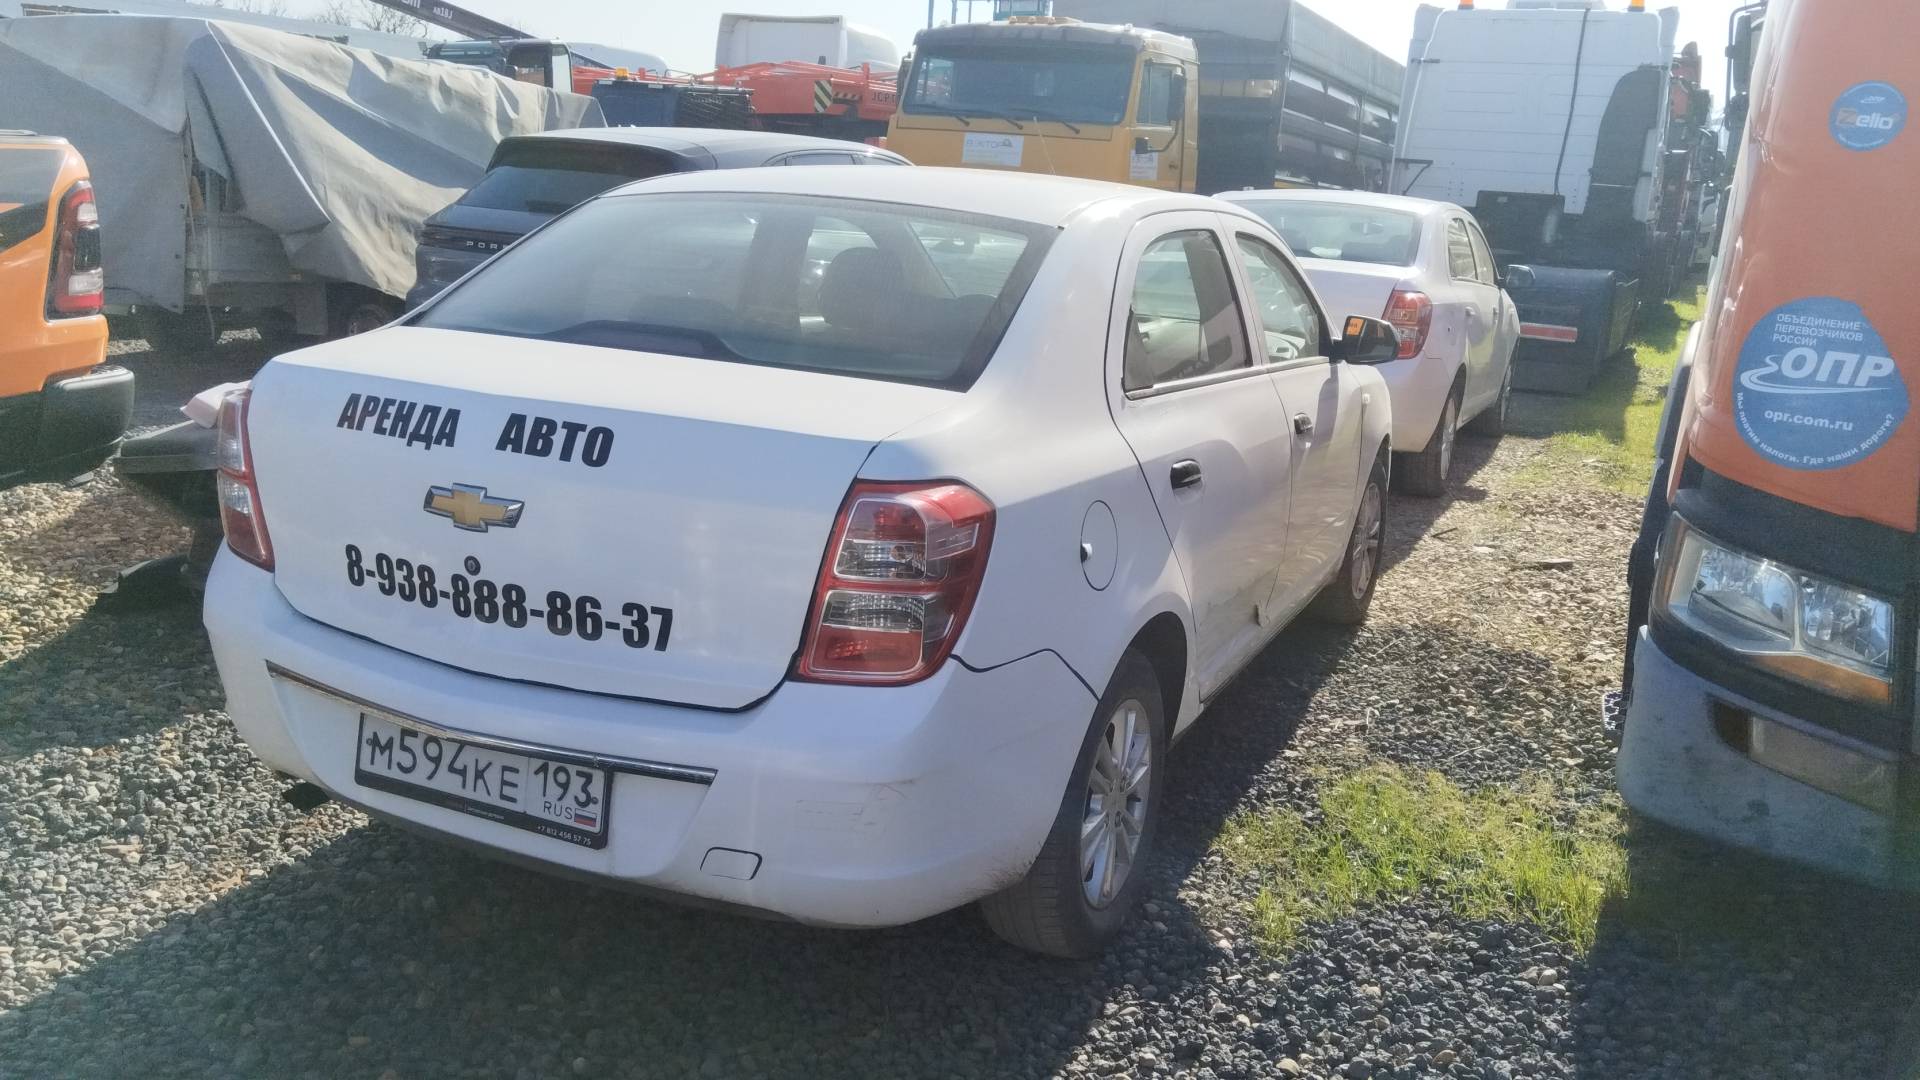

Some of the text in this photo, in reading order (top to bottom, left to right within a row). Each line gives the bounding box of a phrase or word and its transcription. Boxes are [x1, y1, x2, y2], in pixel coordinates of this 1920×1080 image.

[1774, 323, 1864, 341] ПЕРЕВОЗЧИКОВ
[1777, 313, 1861, 331] ОБЪЕДИНЕНИЕ
[1772, 334, 1817, 346] РОССИИ
[1780, 346, 1895, 387] ОПР
[336, 393, 615, 468] АРЕНДА АВТО
[1764, 409, 1854, 431] opr.com.ru
[1740, 411, 1761, 444] платим
[1759, 441, 1800, 464] налоги.
[1802, 455, 1824, 465] Где
[1827, 446, 1859, 463] наши
[1860, 413, 1895, 451] дороги?
[345, 543, 674, 652] 8-938-888-86-37
[534, 761, 593, 808] 193
[543, 801, 573, 820] RUS
